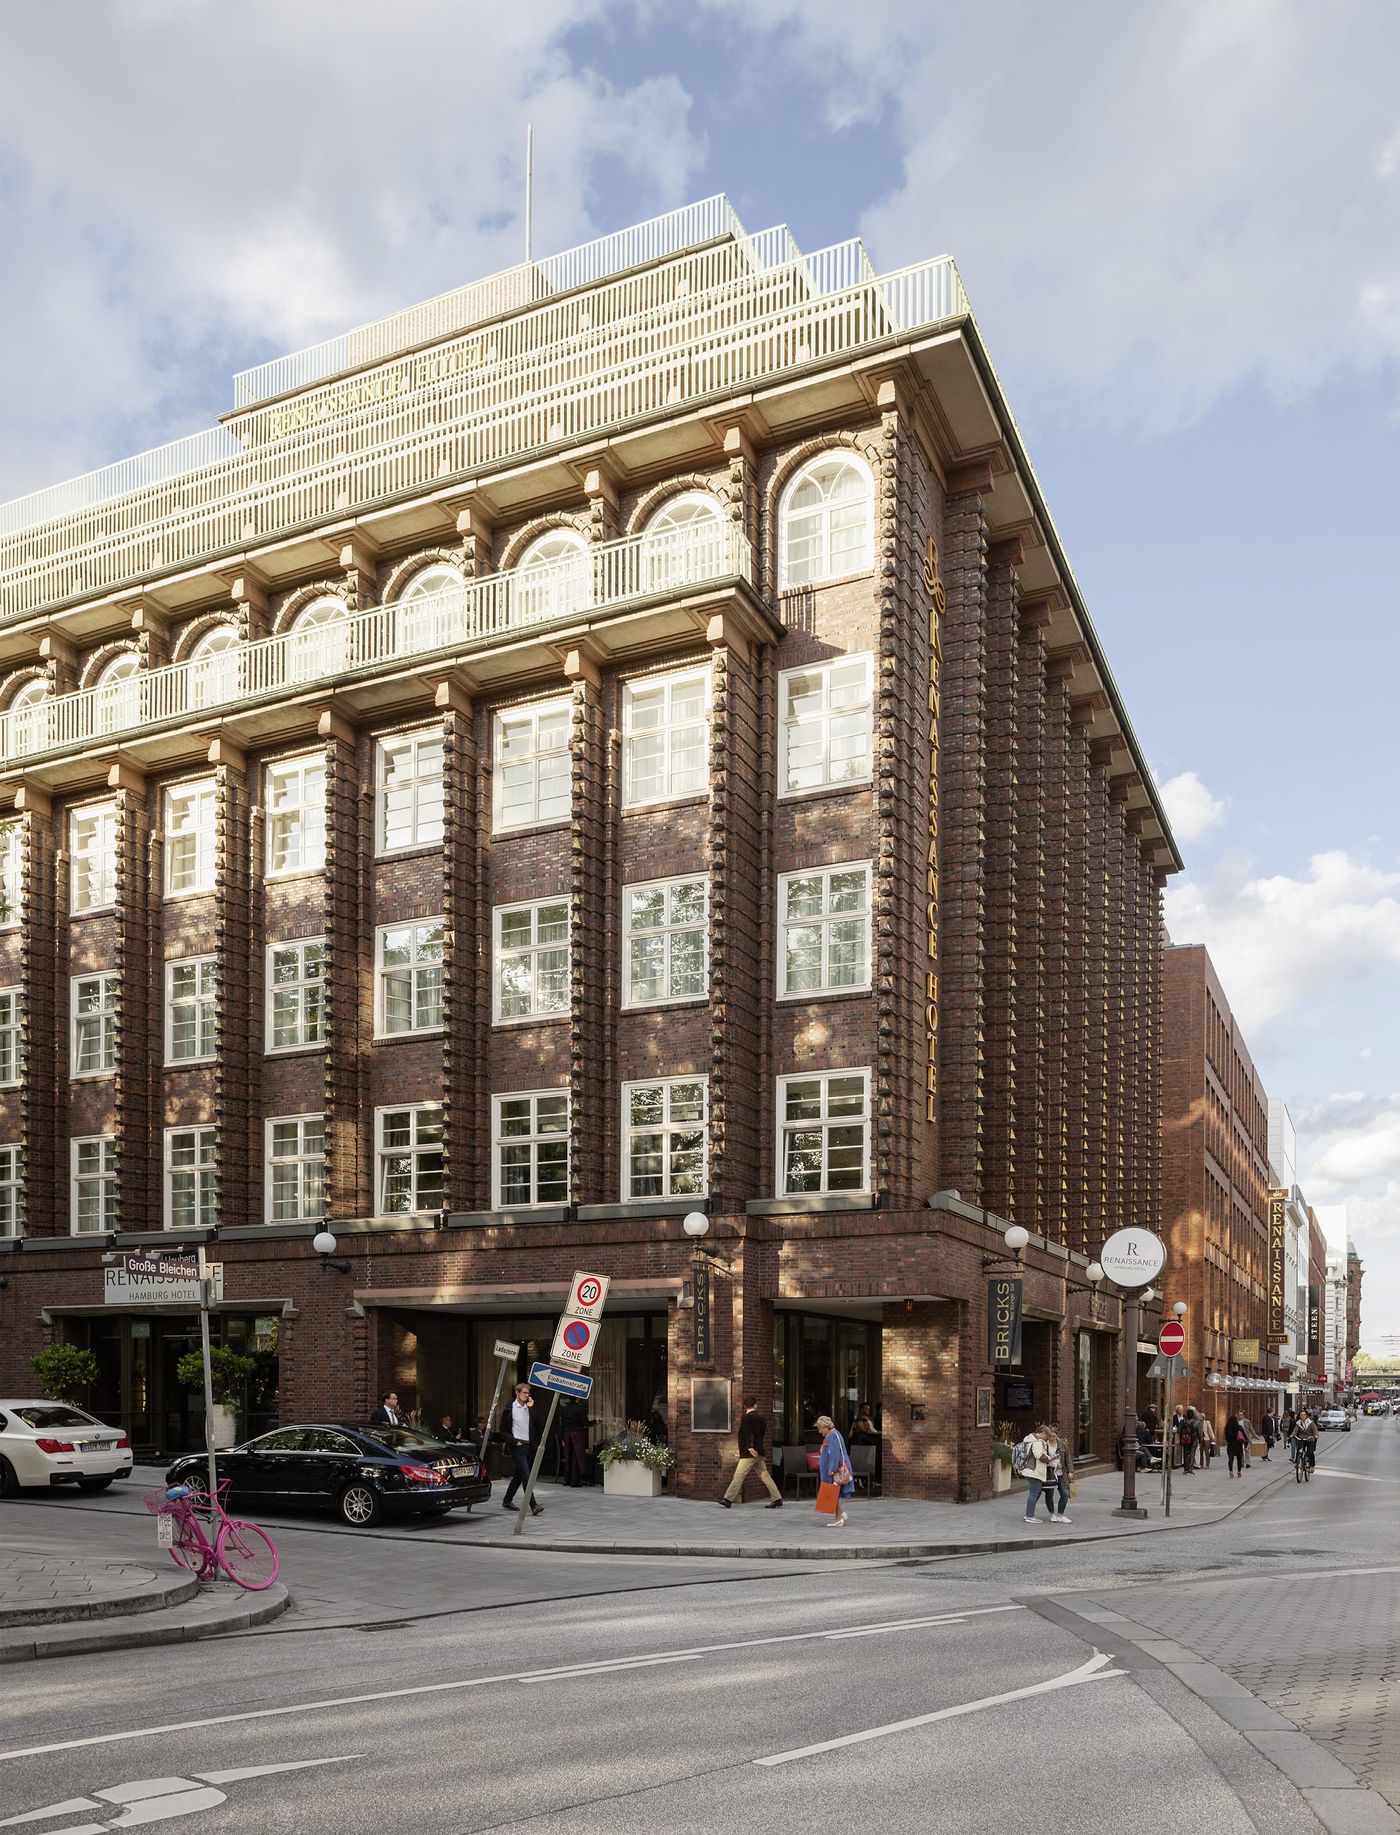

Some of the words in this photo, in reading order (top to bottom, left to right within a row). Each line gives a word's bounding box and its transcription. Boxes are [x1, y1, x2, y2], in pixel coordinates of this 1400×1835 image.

[927, 607, 944, 960] RENAISSANCE
[926, 971, 939, 1122] HOTEL
[1126, 1242, 1140, 1257] R
[128, 1258, 157, 1273] Große
[160, 1261, 198, 1277] Bleichen
[1271, 1202, 1284, 1330] RENAISSANCE
[129, 1291, 169, 1301] HAMBURG
[171, 1290, 197, 1300] HOTEL
[582, 1284, 597, 1300] 20
[574, 1306, 594, 1316] ZONE
[995, 1283, 1010, 1359] BRICKS
[561, 1349, 582, 1360] ZONE
[547, 1374, 587, 1391] Einbahnstraße
